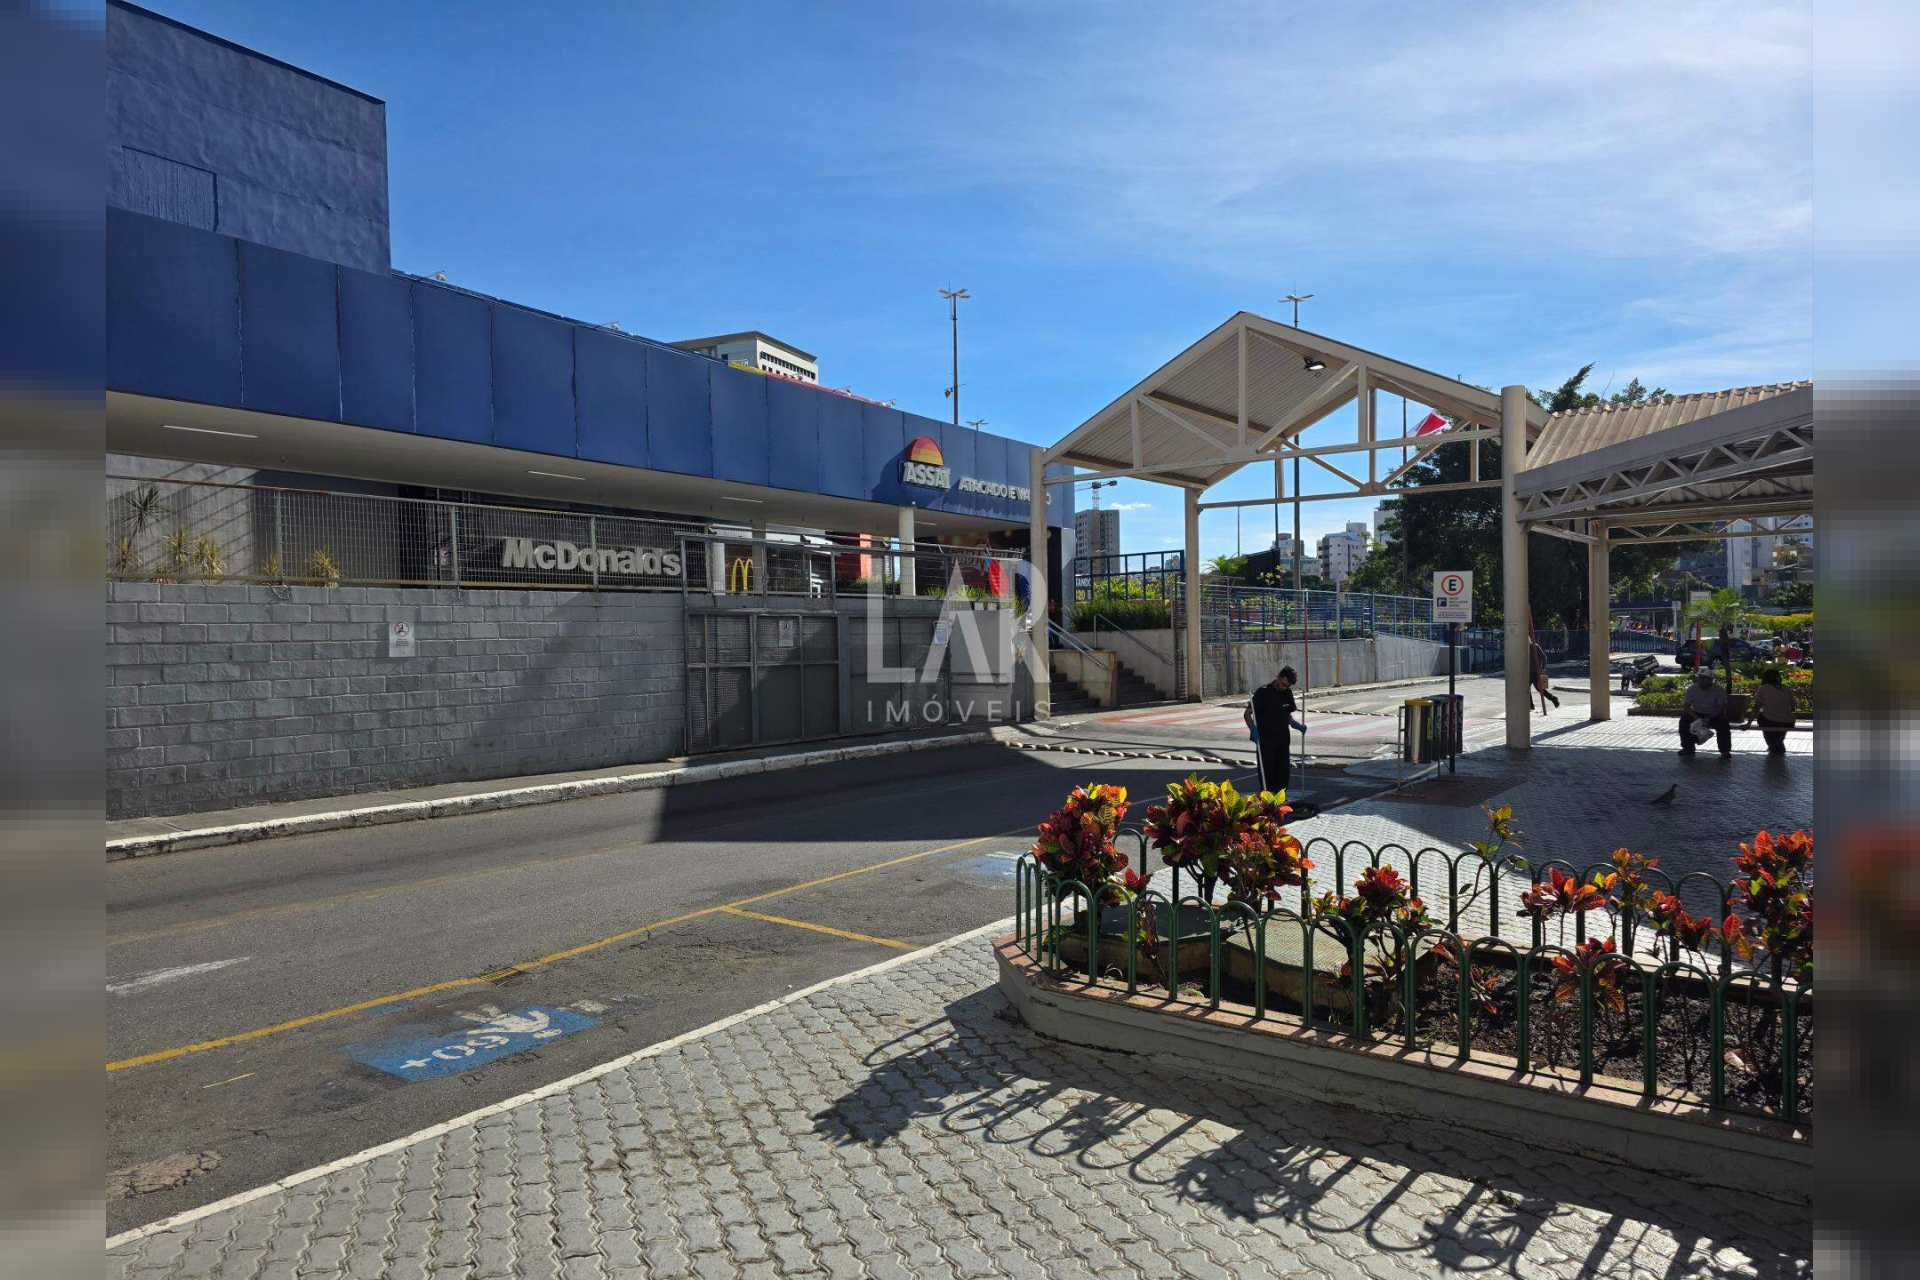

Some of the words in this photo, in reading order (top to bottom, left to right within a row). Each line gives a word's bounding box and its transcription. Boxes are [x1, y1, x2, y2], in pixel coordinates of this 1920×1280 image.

[958, 476, 1008, 498] ATACADO
[1008, 485, 1017, 500] E
[1017, 487, 1052, 505] VAO
[1448, 579, 1457, 591] E
